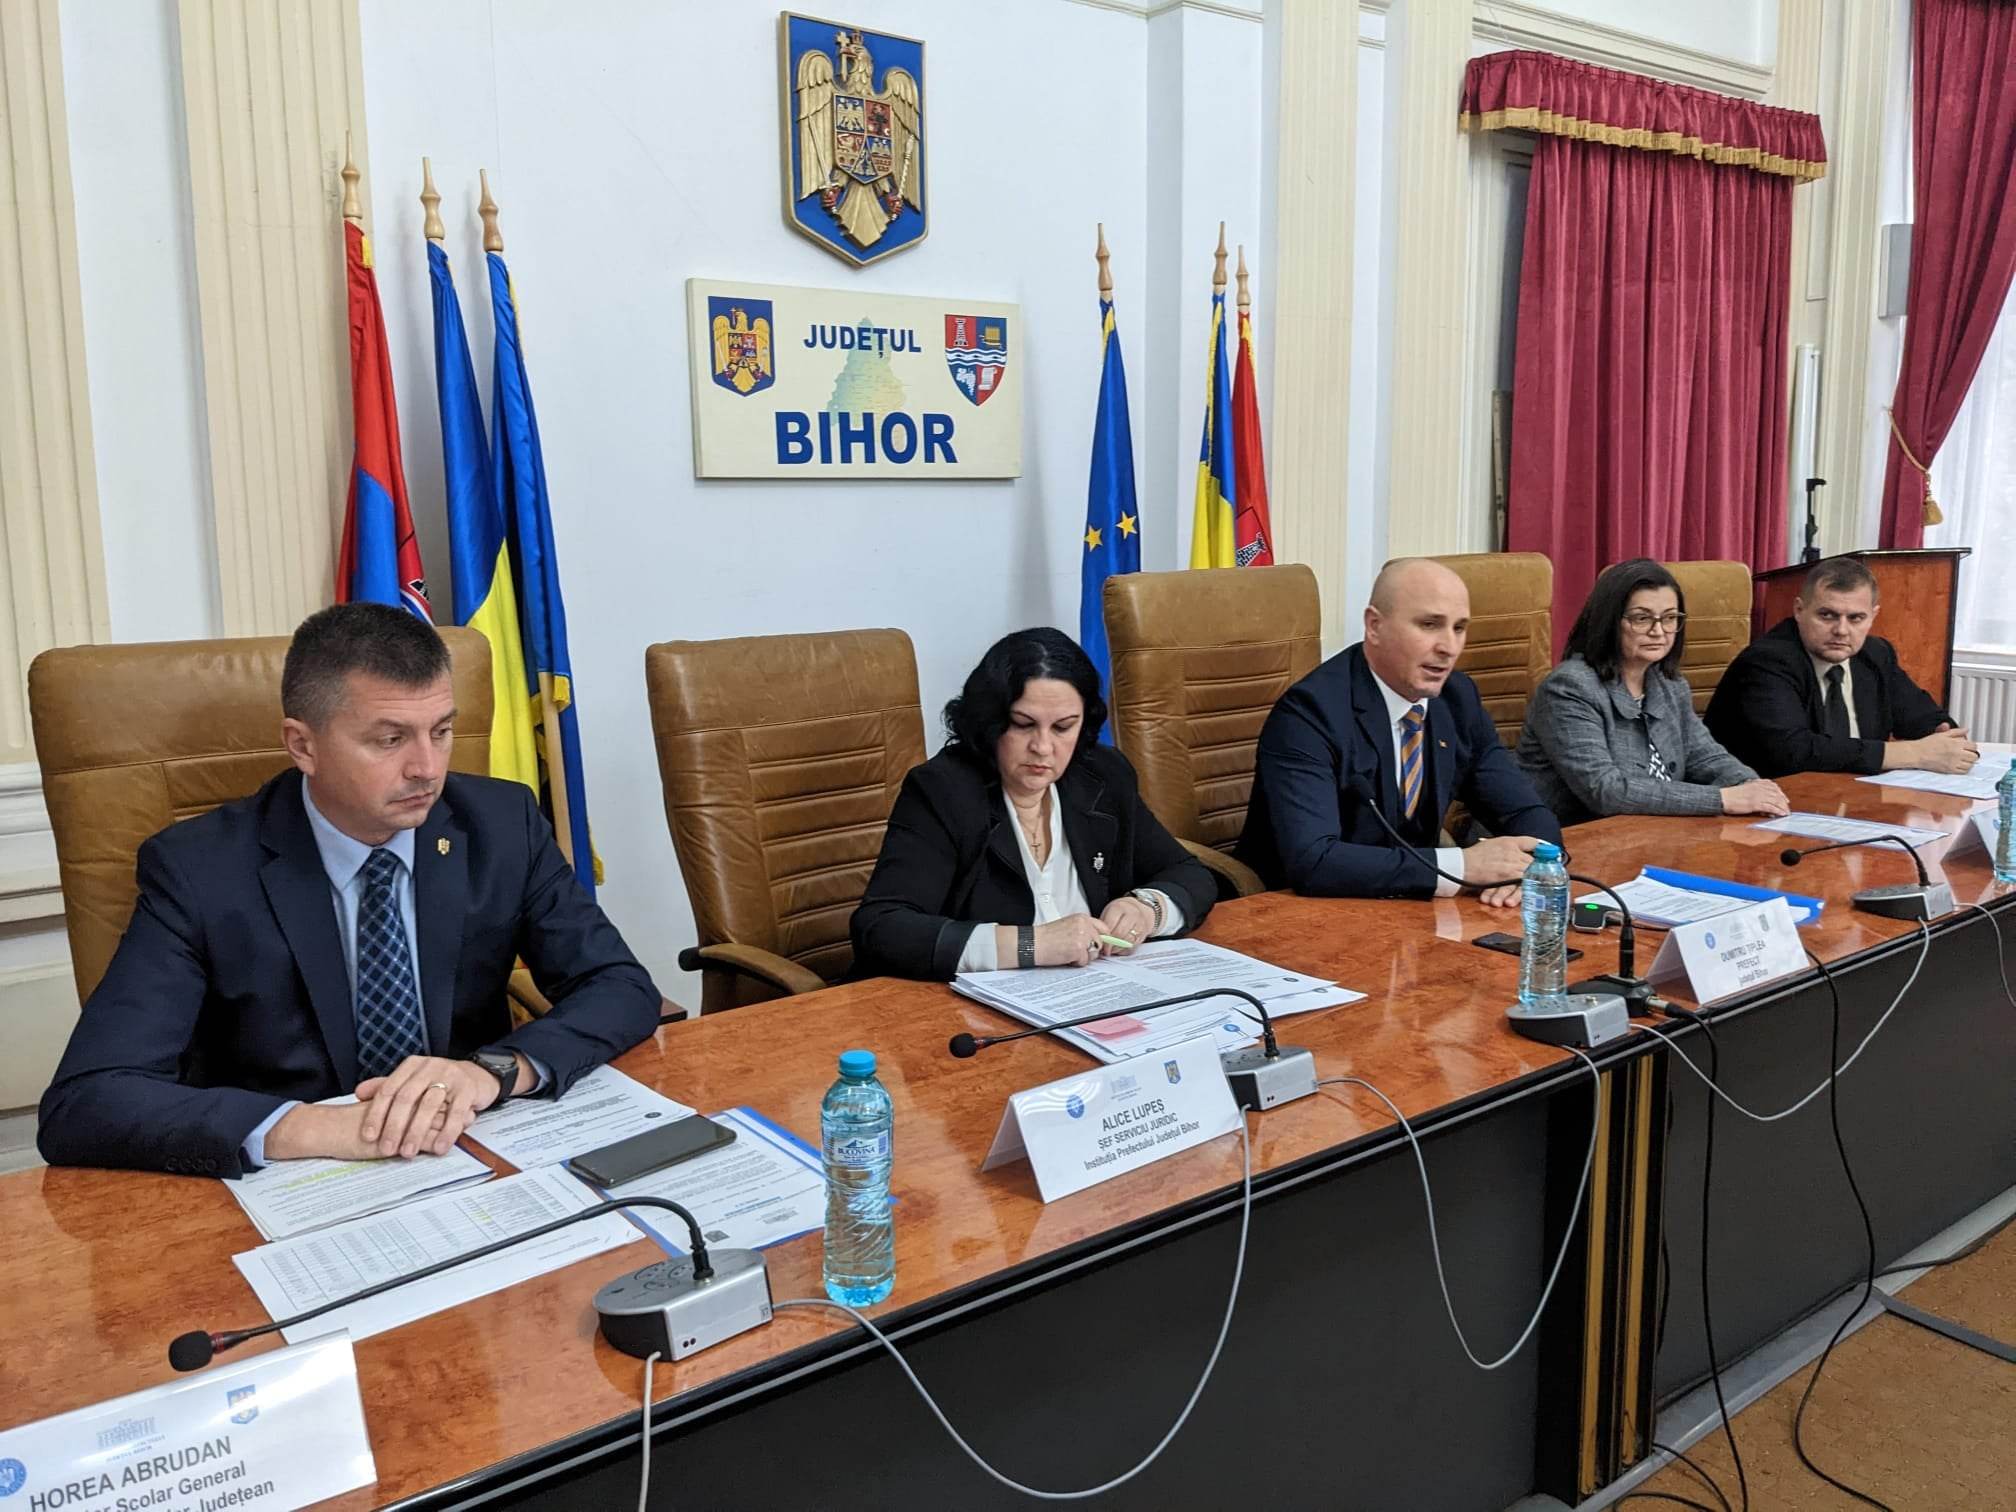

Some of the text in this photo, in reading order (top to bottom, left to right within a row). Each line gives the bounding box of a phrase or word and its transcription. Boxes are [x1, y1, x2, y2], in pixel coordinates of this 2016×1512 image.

[803, 324, 922, 359] JUDEȚUL
[774, 410, 958, 466] BIHOR
[1735, 955, 1761, 969] PREFECT
[1102, 1098, 1166, 1132] ALICE LUPEȘ
[1114, 1122, 1149, 1144] SERVICIU
[1150, 1112, 1178, 1131] JURIDIC
[1117, 1135, 1155, 1159] Prefectului
[1181, 1120, 1201, 1134] Bihor
[29, 1473, 115, 1512] HOREA
[121, 1435, 233, 1488] ABRUDAN
[178, 1460, 247, 1496] General
[199, 1478, 275, 1512] Județean
